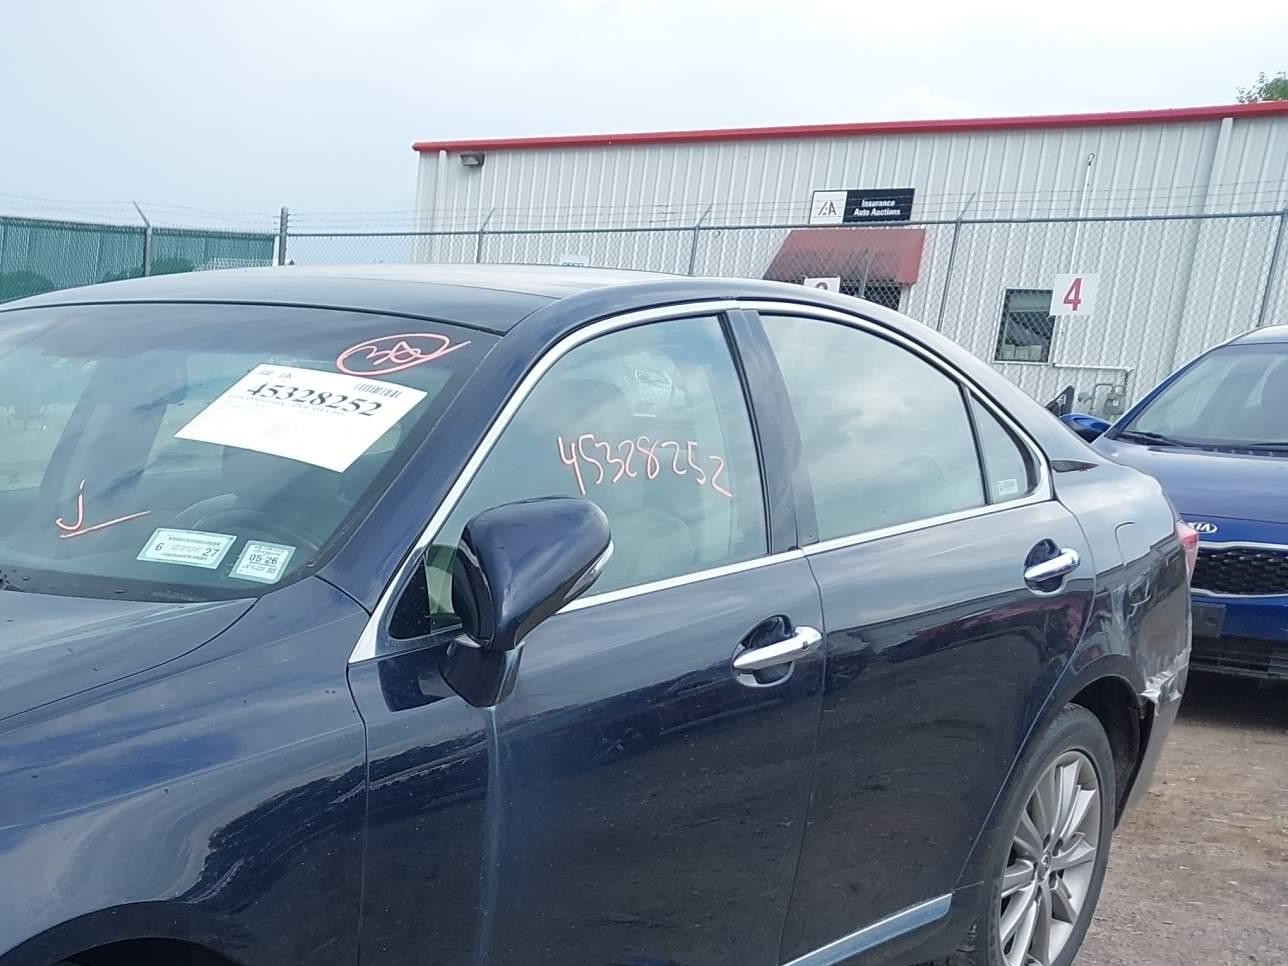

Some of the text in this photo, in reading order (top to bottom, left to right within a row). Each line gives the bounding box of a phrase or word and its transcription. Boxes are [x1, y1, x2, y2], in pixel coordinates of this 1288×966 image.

[861, 199, 896, 208] Insurance
[853, 207, 901, 217] Auto Auctions
[1063, 277, 1082, 312] 4
[246, 382, 383, 417] 45328252
[557, 433, 734, 497] 45328252
[202, 547, 220, 557] 27
[264, 556, 279, 565] 26
